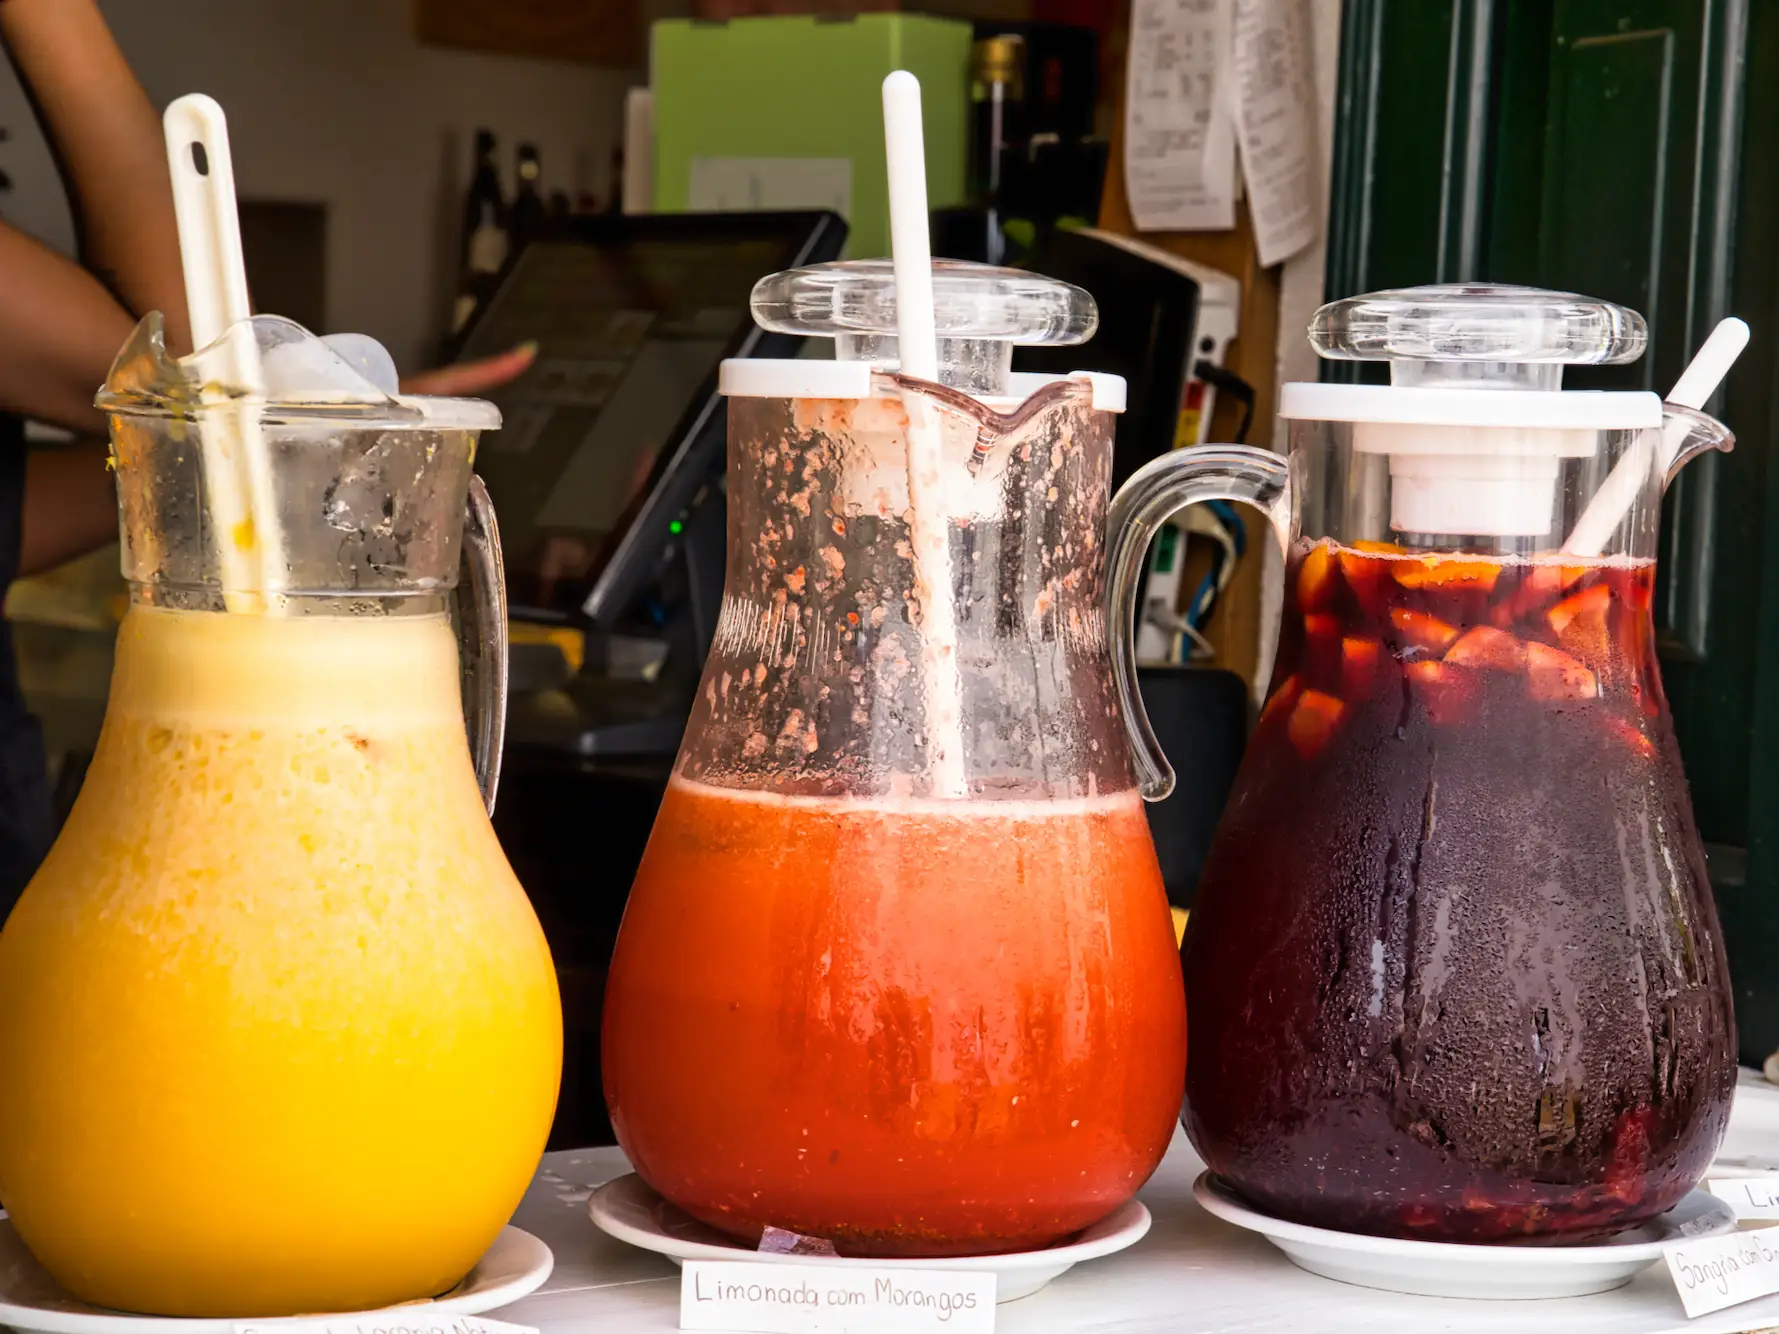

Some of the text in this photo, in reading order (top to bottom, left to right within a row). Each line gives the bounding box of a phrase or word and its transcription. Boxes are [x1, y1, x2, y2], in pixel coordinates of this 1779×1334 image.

[1744, 1184, 1779, 1208] Li
[695, 1271, 977, 1322] Limonada com Morangos
